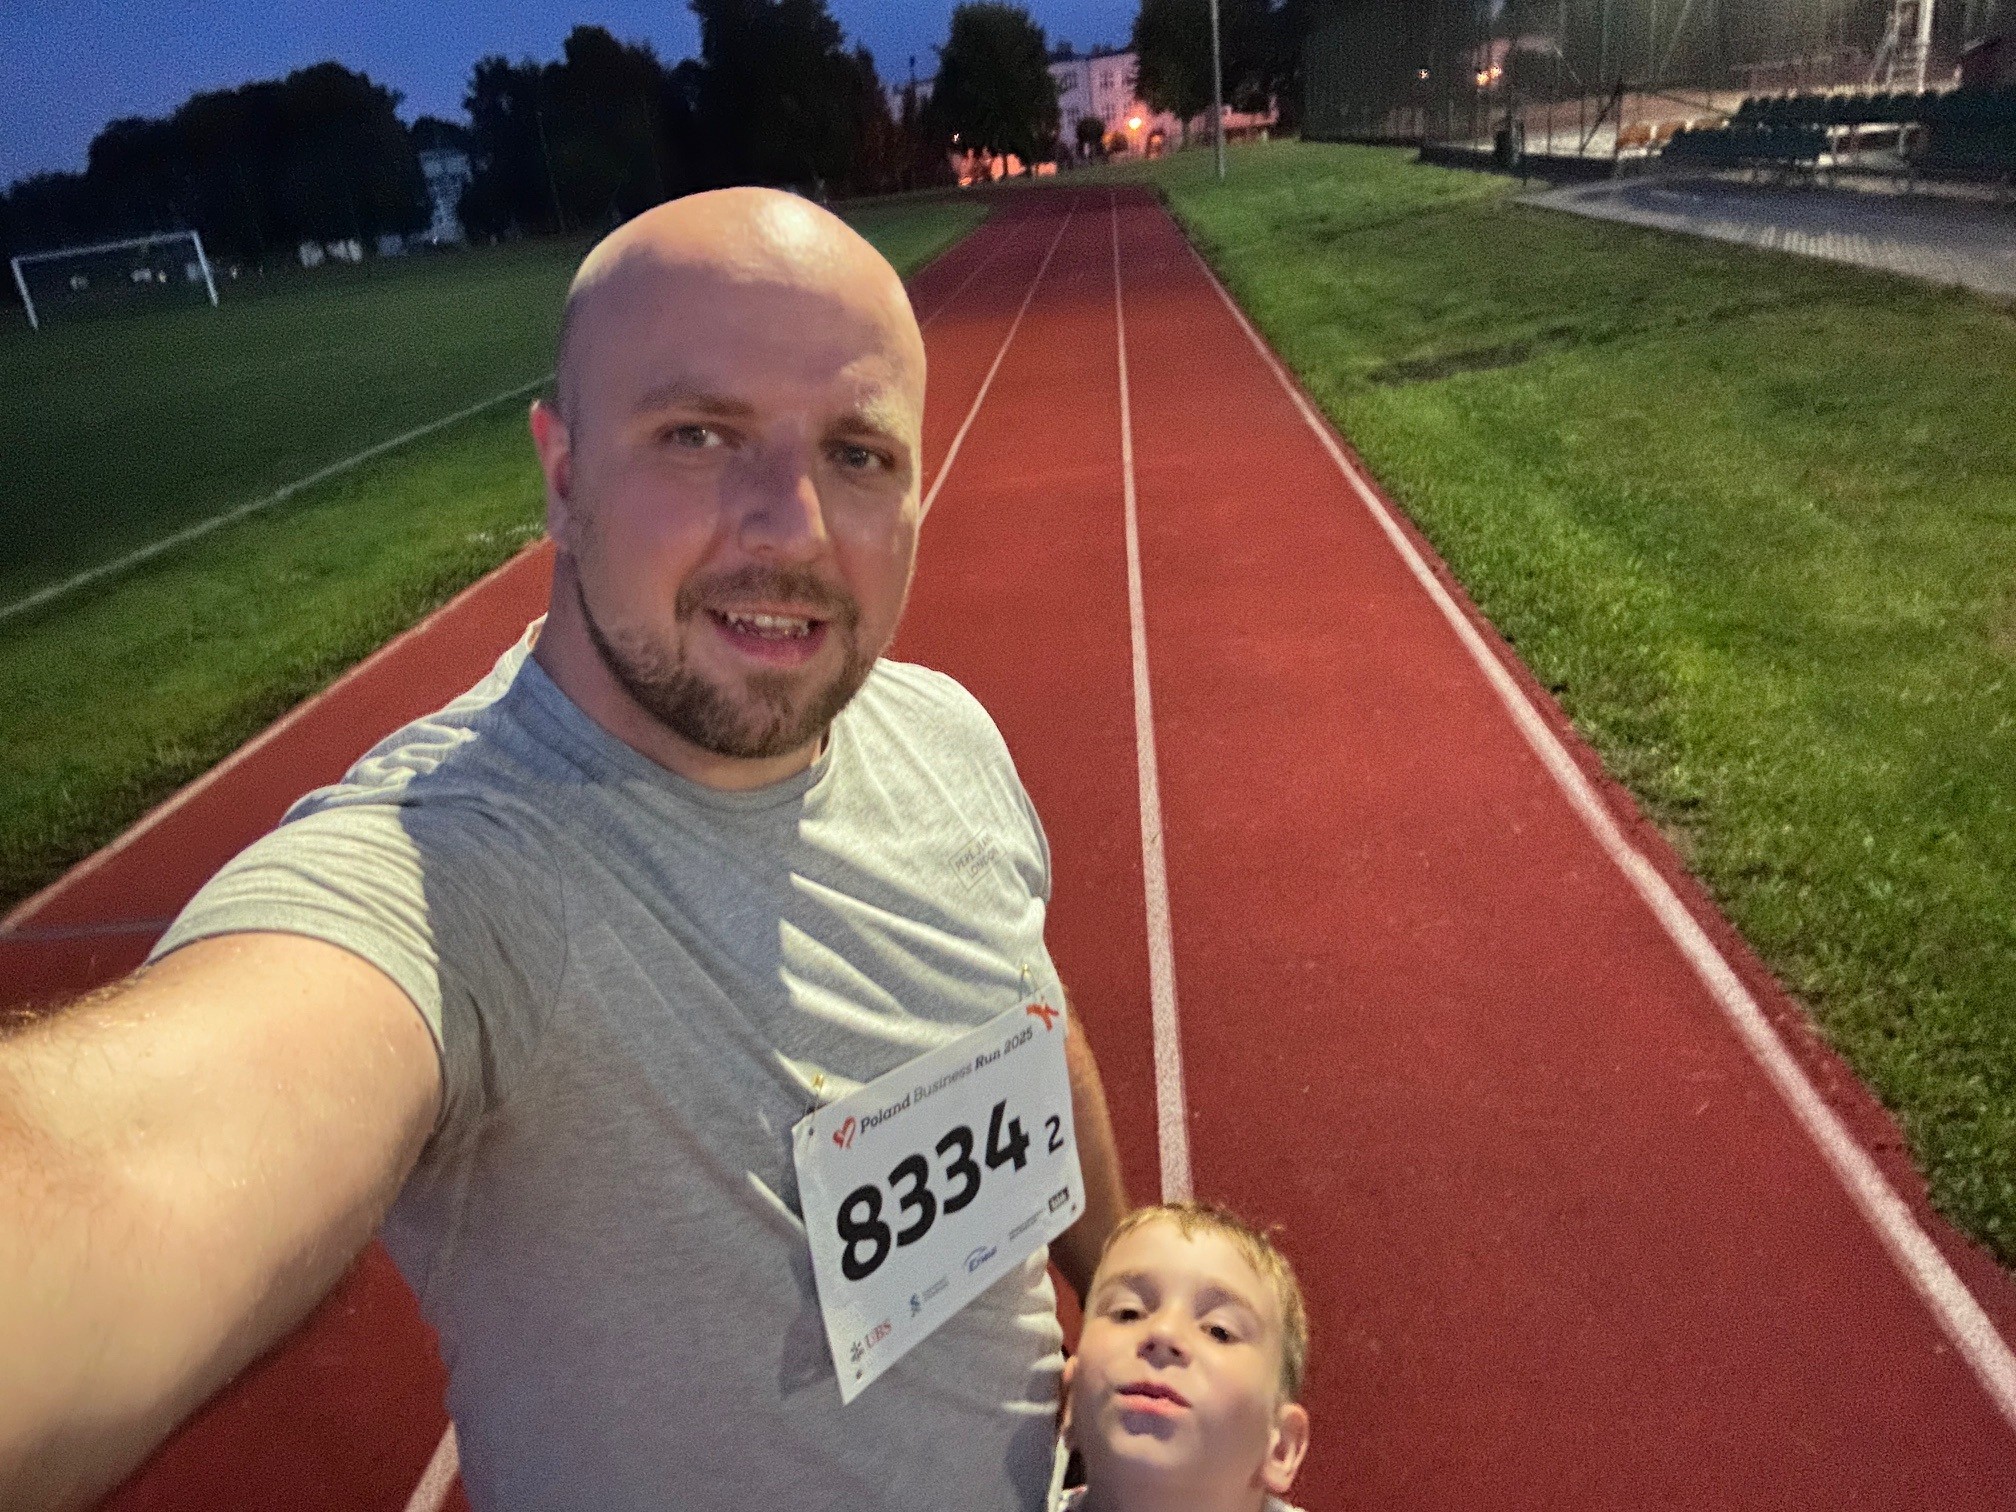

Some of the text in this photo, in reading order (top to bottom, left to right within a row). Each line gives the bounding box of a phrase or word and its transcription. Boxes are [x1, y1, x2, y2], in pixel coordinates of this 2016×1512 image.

[860, 1026, 1034, 1134] Poland Business Run 2025
[836, 1098, 1064, 1281] 8334 2
